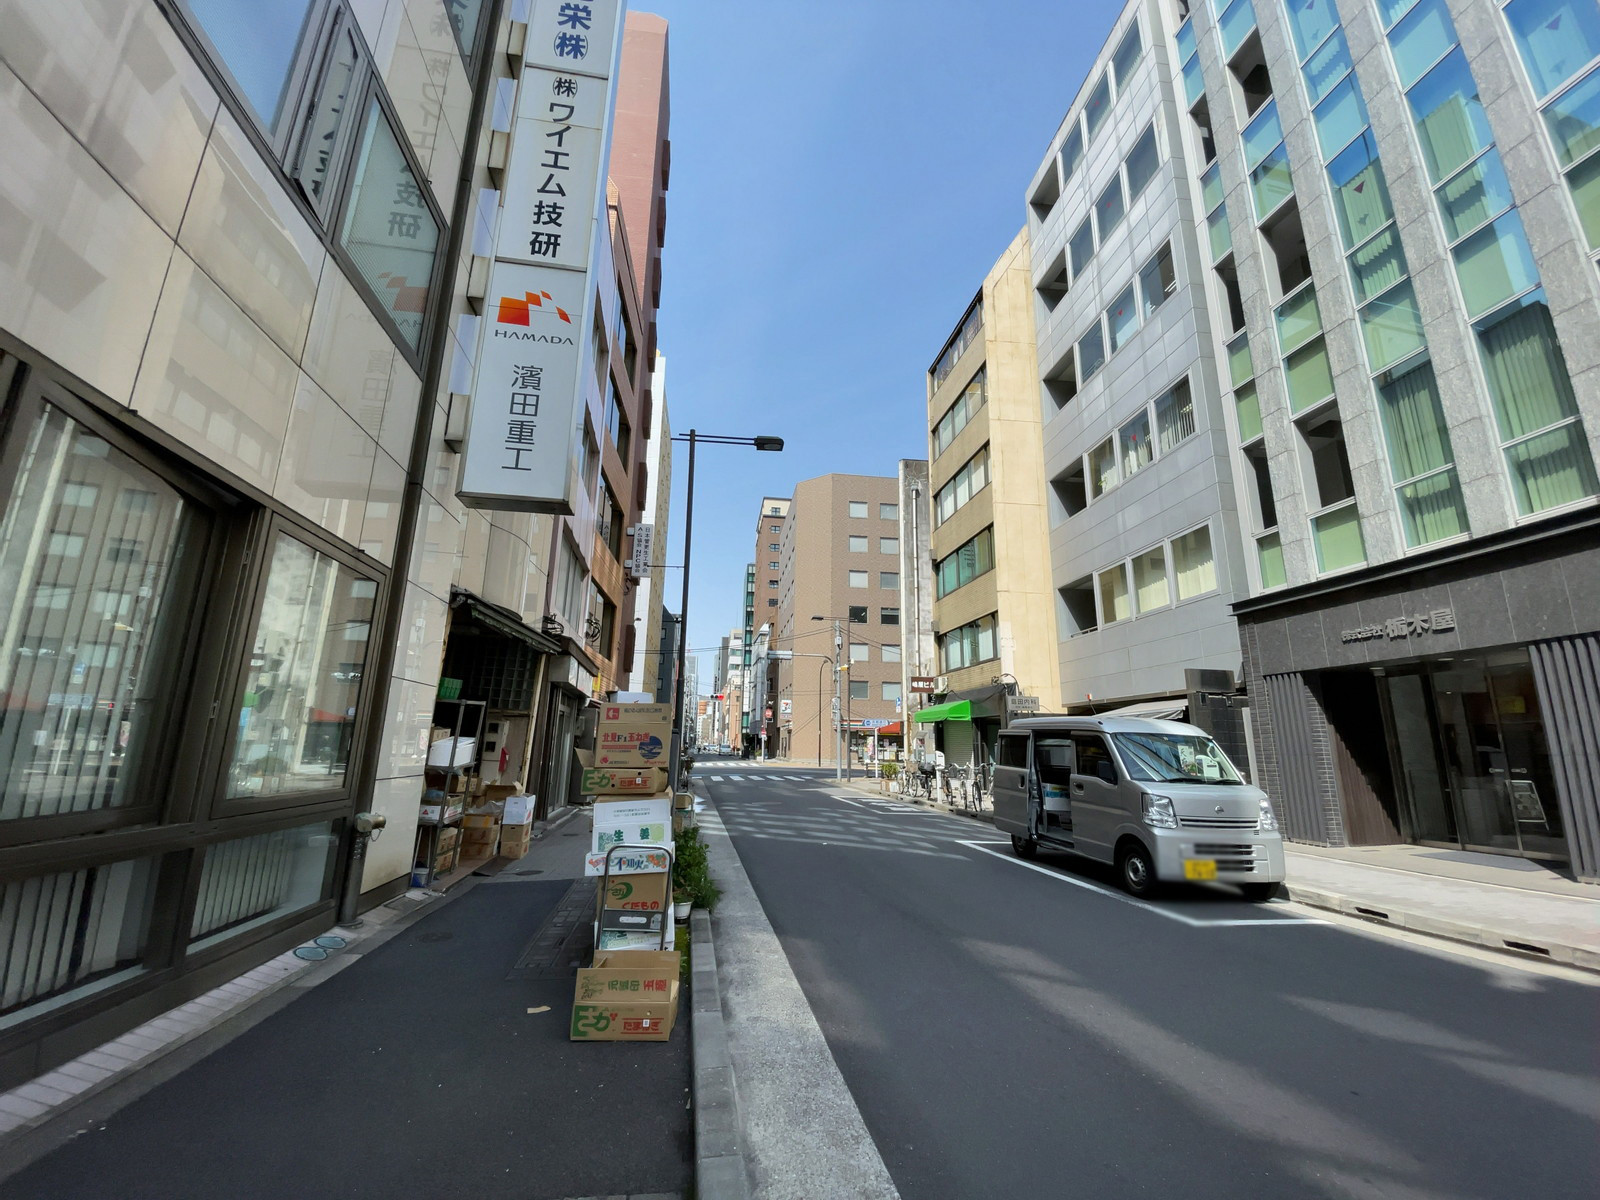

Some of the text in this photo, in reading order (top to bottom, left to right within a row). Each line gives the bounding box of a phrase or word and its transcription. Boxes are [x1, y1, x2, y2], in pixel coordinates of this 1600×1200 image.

[553, 0, 593, 60] 栄㈱
[494, 329, 574, 345] HAMADA
[501, 364, 543, 471] 濱田重工
